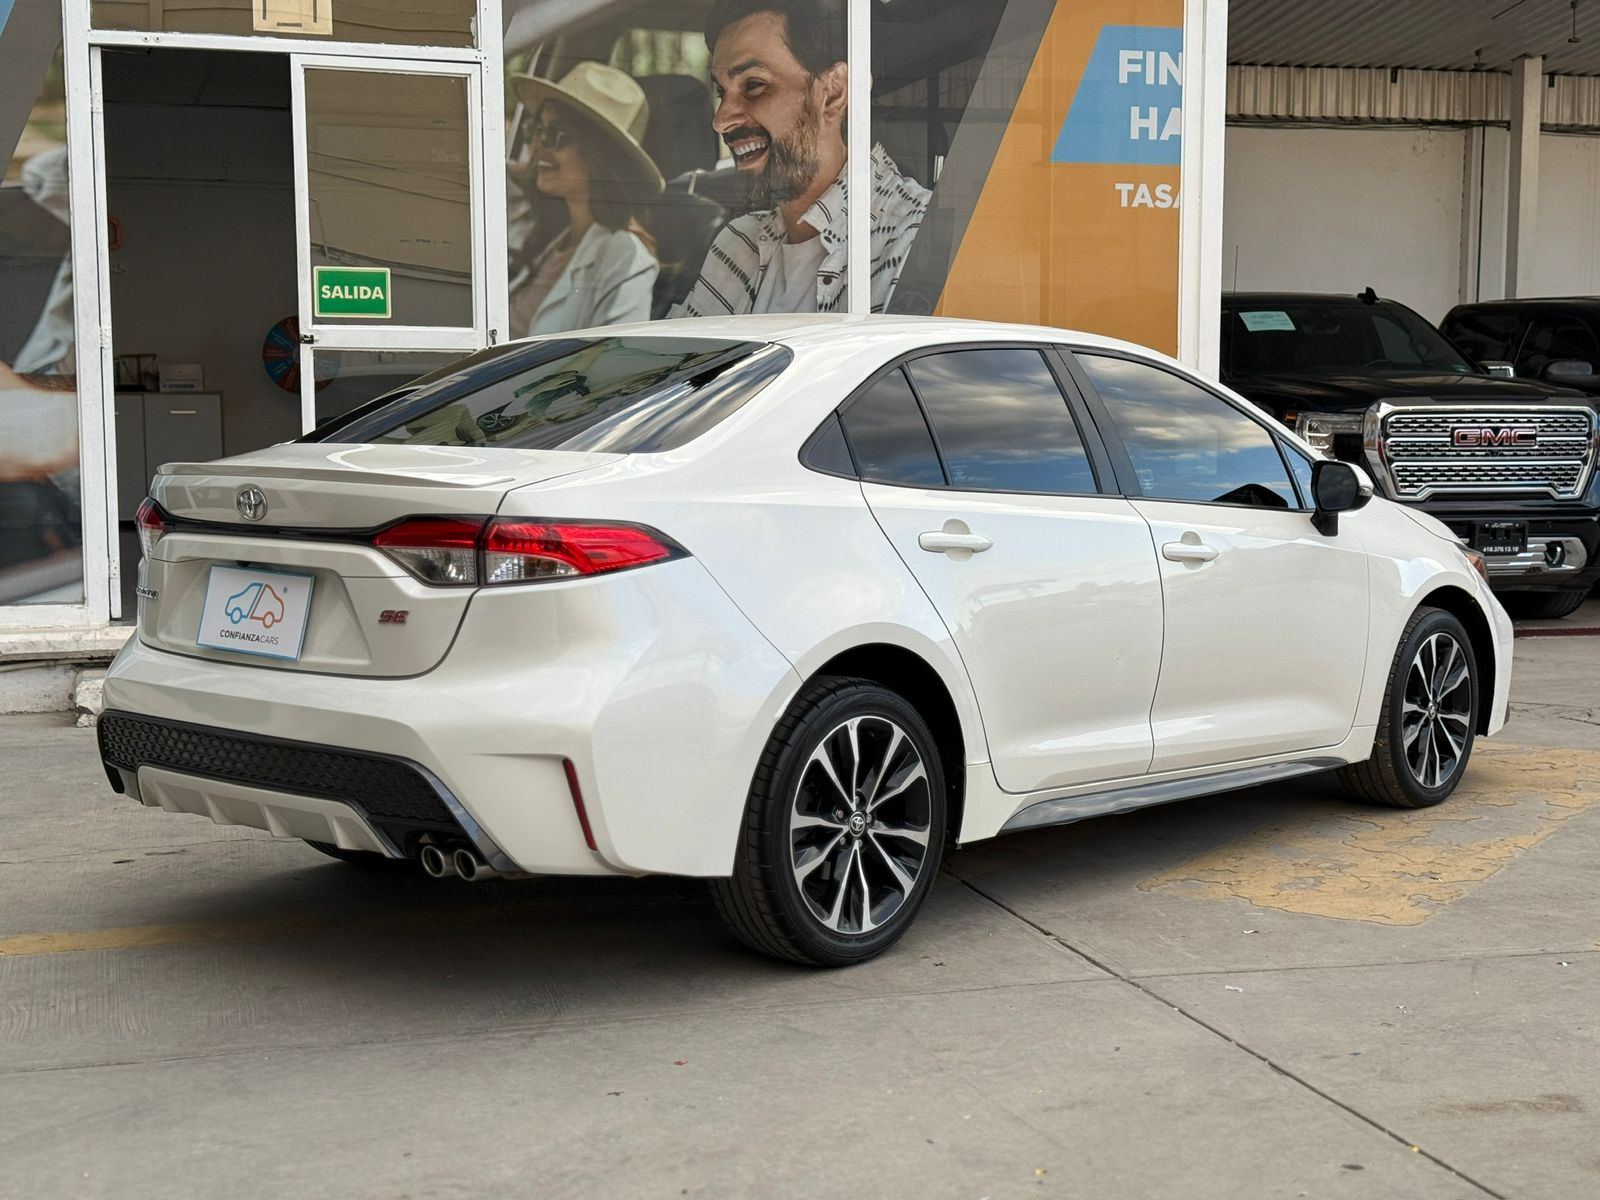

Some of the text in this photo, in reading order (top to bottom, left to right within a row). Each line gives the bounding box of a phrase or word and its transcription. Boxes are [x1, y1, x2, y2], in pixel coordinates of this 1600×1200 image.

[1118, 50, 1183, 86] FIN
[321, 285, 385, 300] SALIDA
[1454, 428, 1537, 446] GMC
[378, 609, 409, 624] SE
[219, 629, 280, 646] CONFIANZACARS
